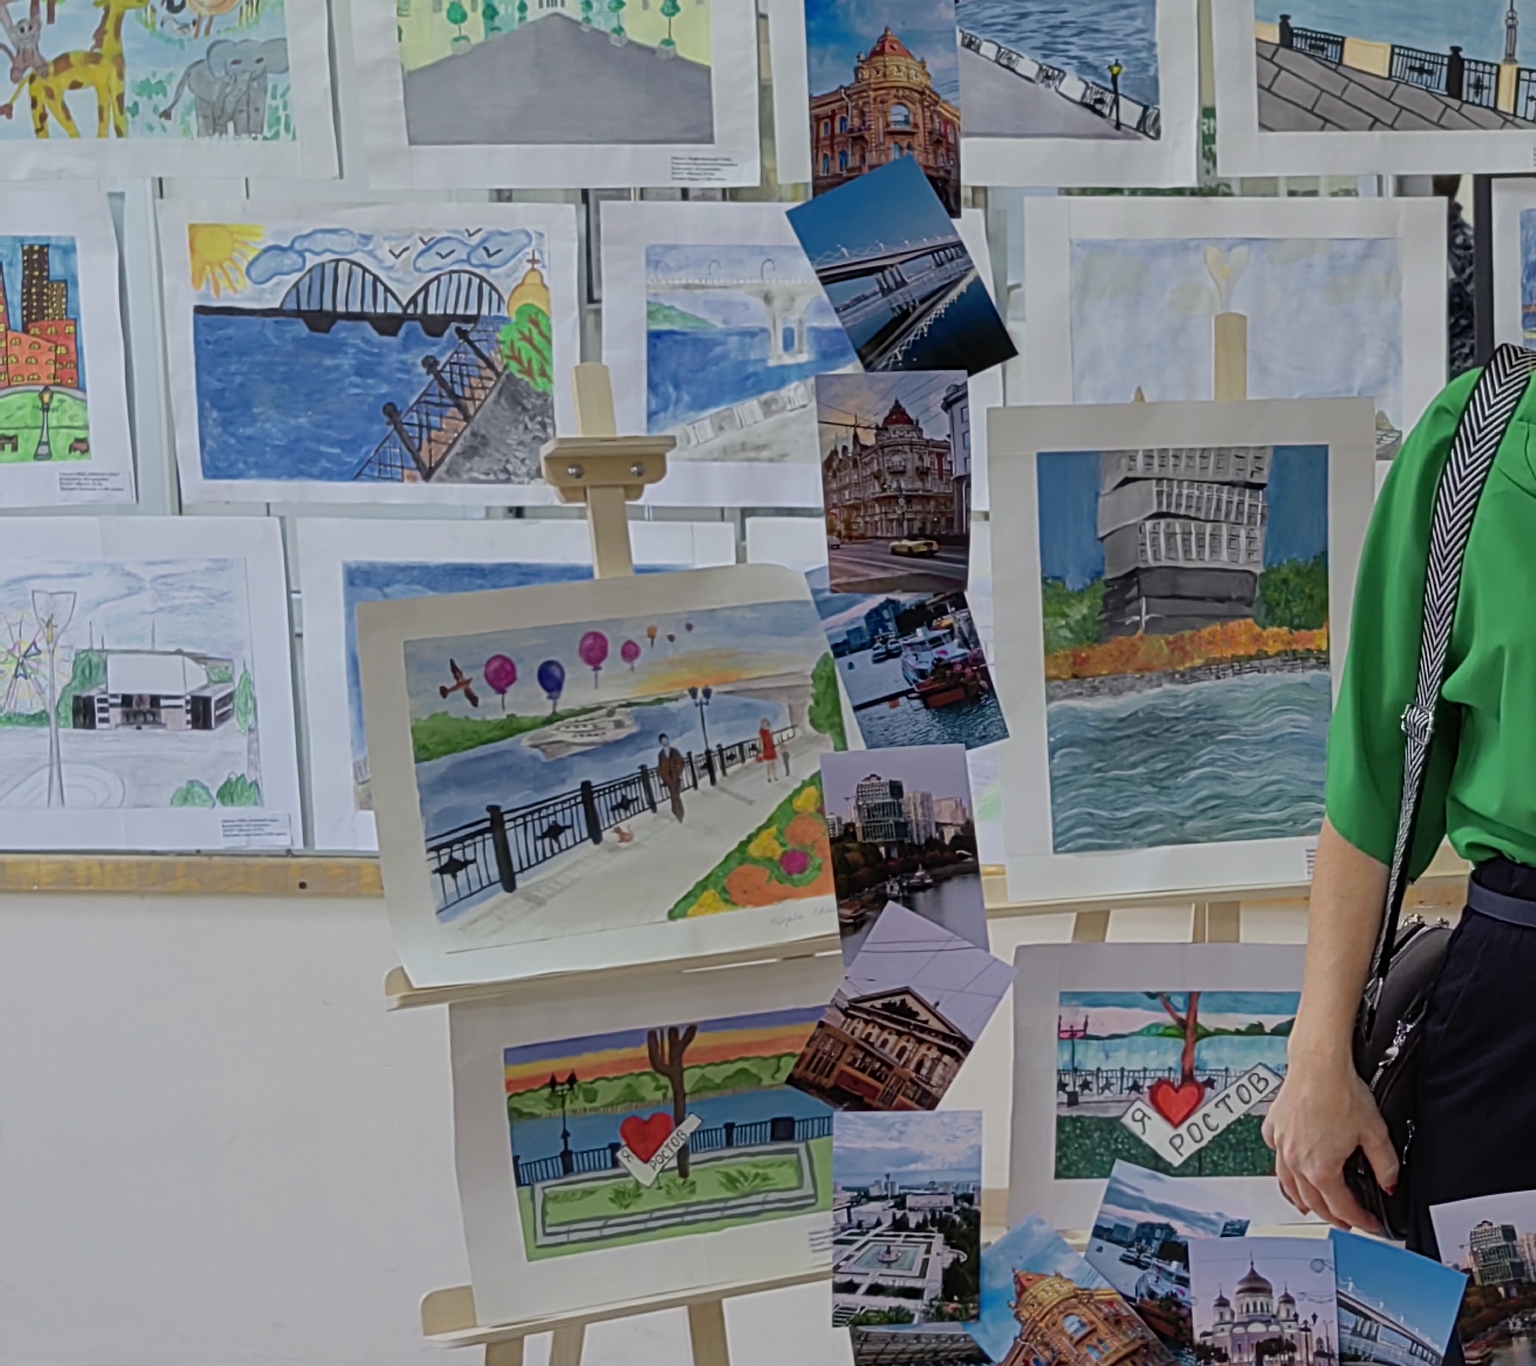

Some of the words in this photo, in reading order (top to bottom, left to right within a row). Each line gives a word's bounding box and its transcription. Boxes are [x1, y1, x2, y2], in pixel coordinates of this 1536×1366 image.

[1131, 1107, 1152, 1135] Я
[1169, 1073, 1269, 1157] РОСТОВ
[648, 1129, 687, 1171] РОСТОВ
